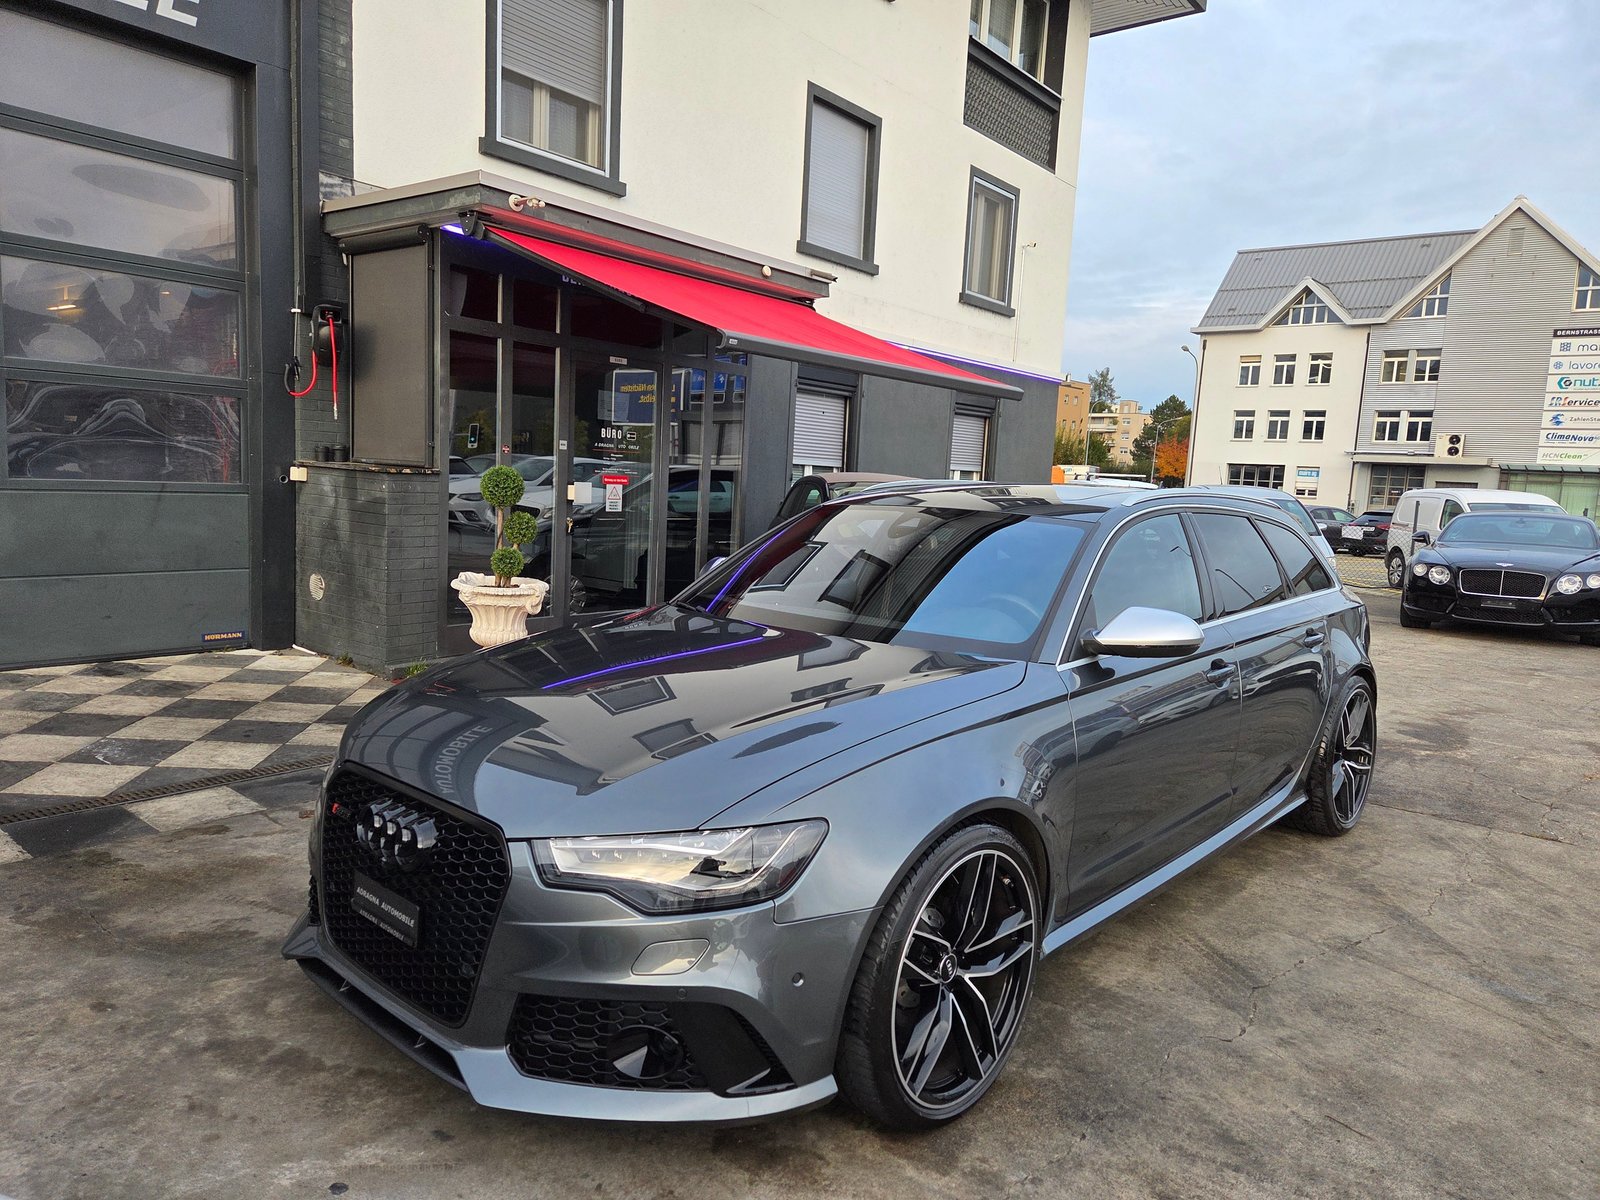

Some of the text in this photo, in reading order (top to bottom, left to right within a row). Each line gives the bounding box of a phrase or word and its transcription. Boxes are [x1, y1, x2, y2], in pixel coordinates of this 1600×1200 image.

[1573, 377, 1600, 387] nut
[600, 427, 622, 439] BÜRO
[1545, 432, 1594, 442] ClimaNova
[1541, 452, 1583, 460] HCNClean
[356, 886, 415, 928] ADRAGNA AUTOMOBILE
